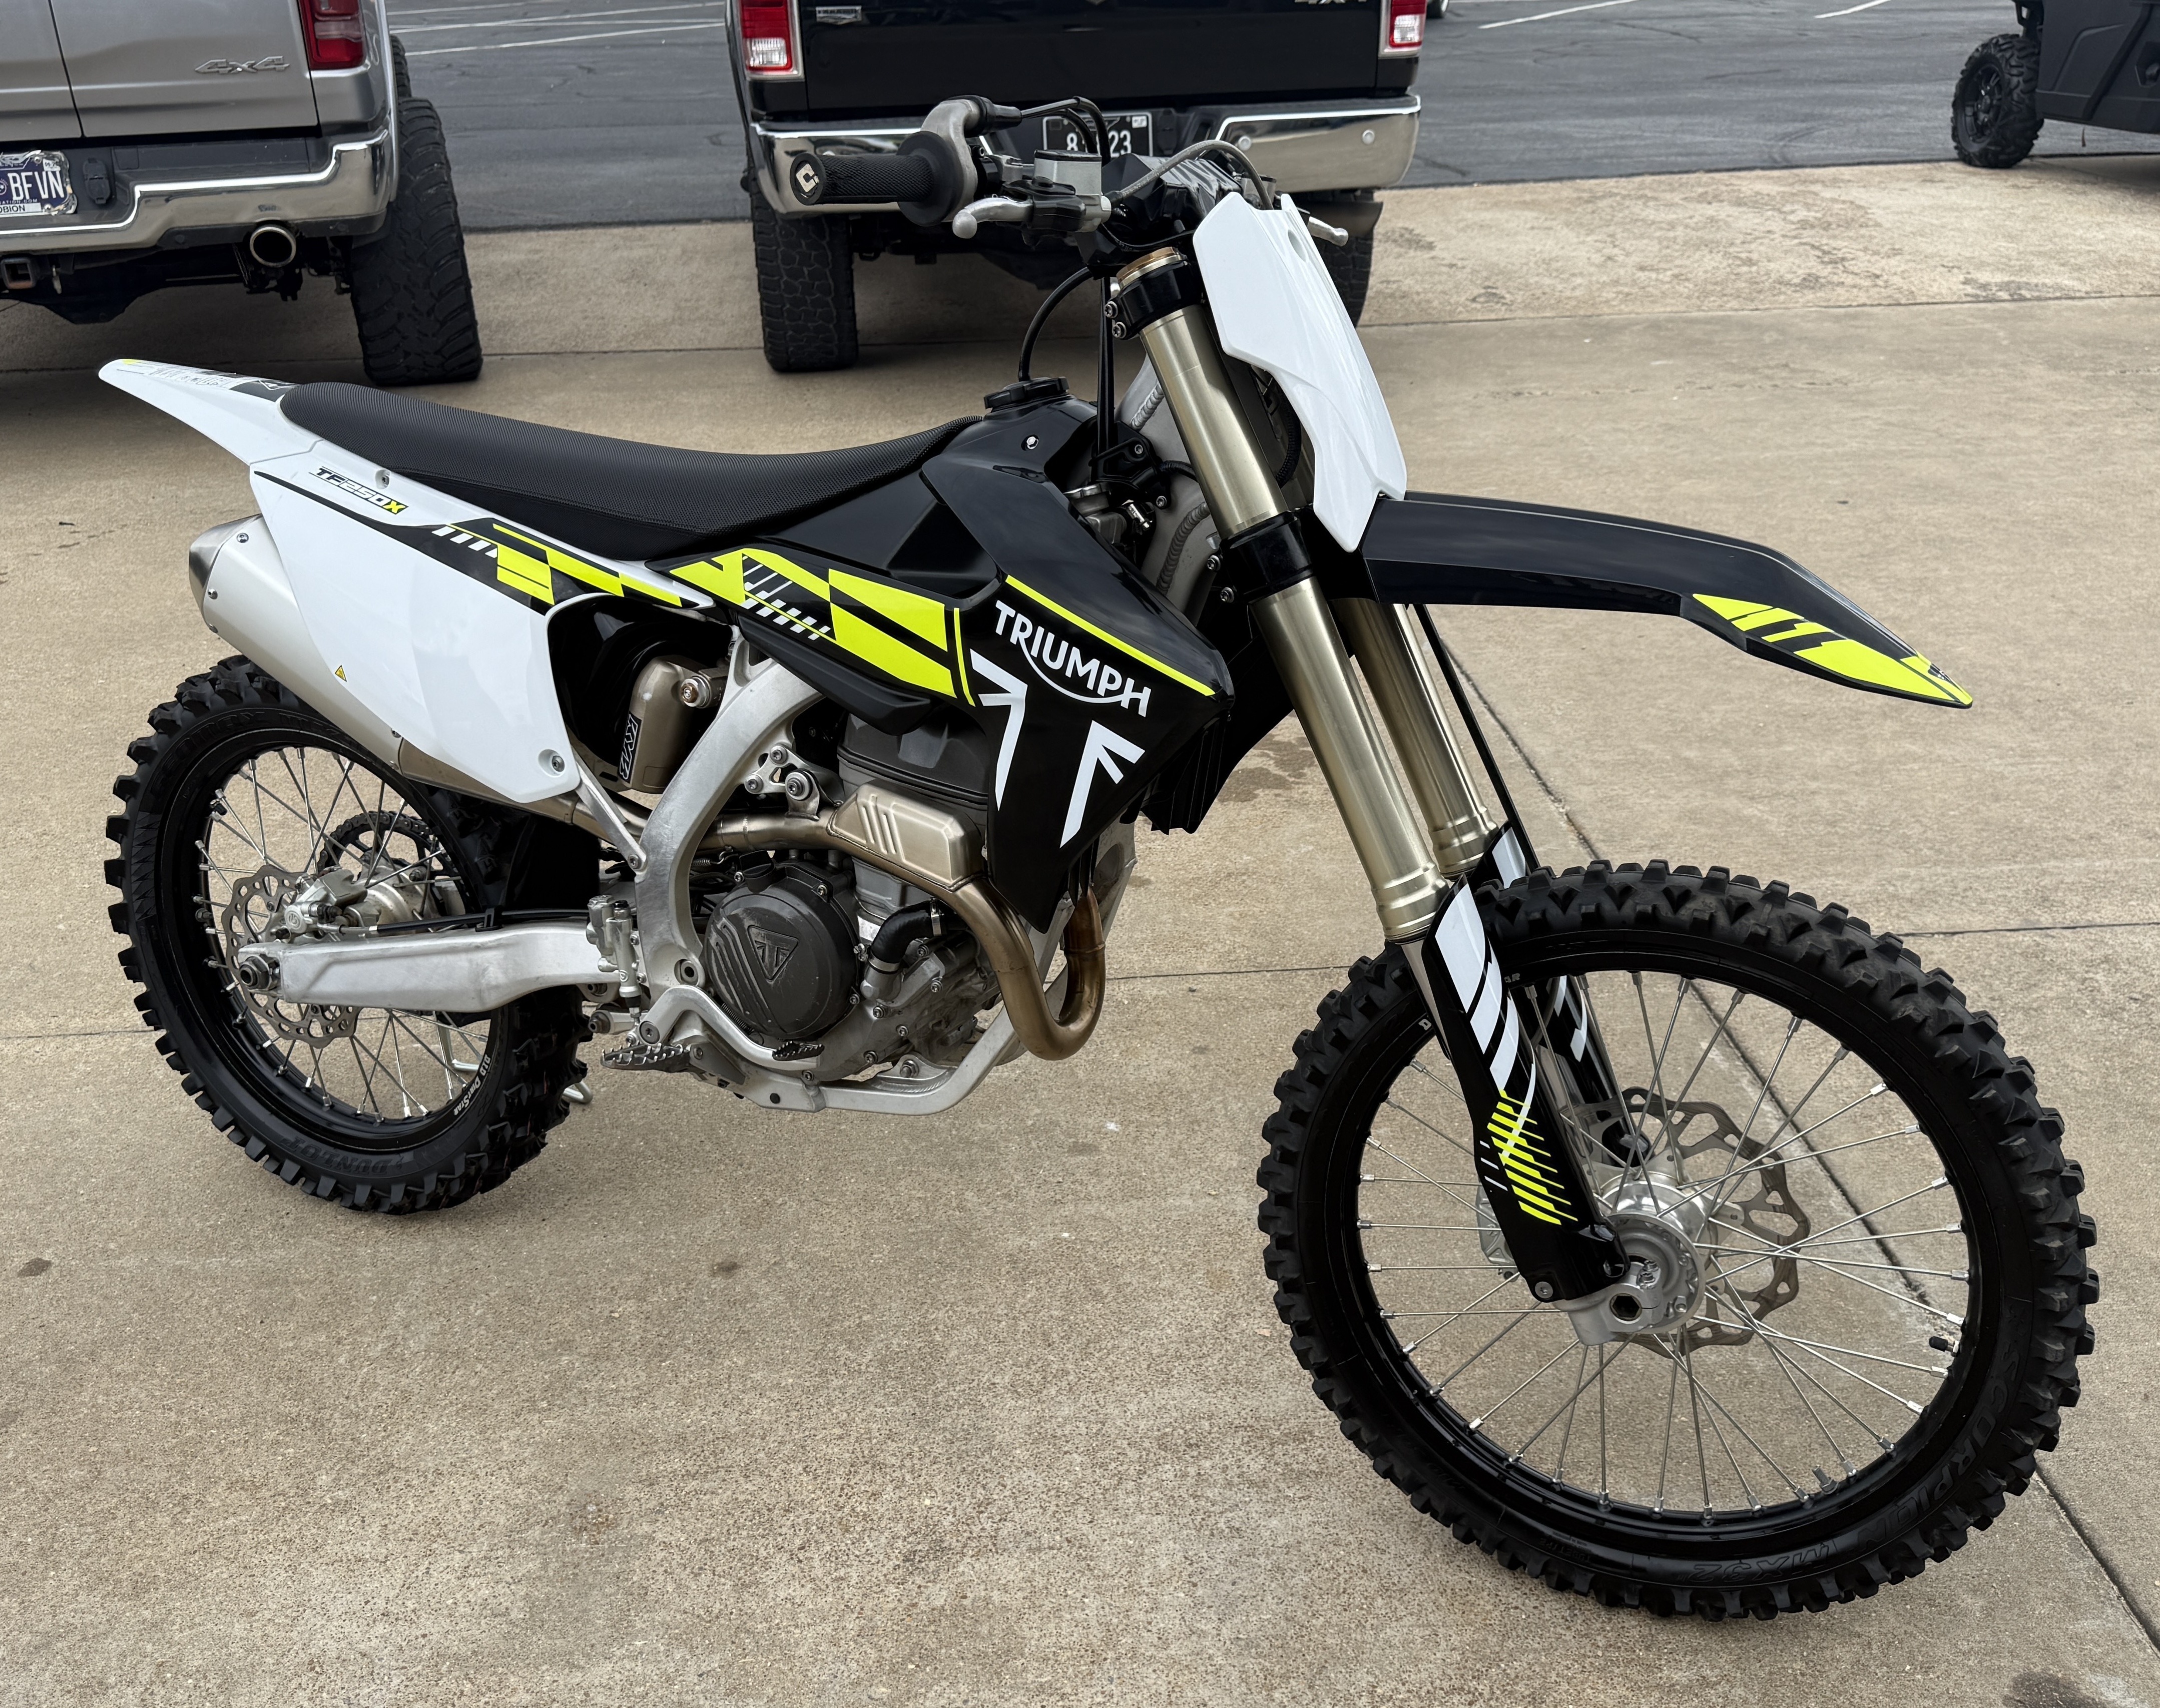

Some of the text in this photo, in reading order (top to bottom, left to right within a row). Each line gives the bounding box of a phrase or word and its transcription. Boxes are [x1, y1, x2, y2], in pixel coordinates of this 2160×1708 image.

[8, 171, 65, 201] BFVN
[995, 600, 1151, 717] TRIUMPH
[619, 714, 639, 780] KYB
[278, 1136, 393, 1176] DUNLOP
[1688, 1342, 2021, 1583] SCORPION MX32
